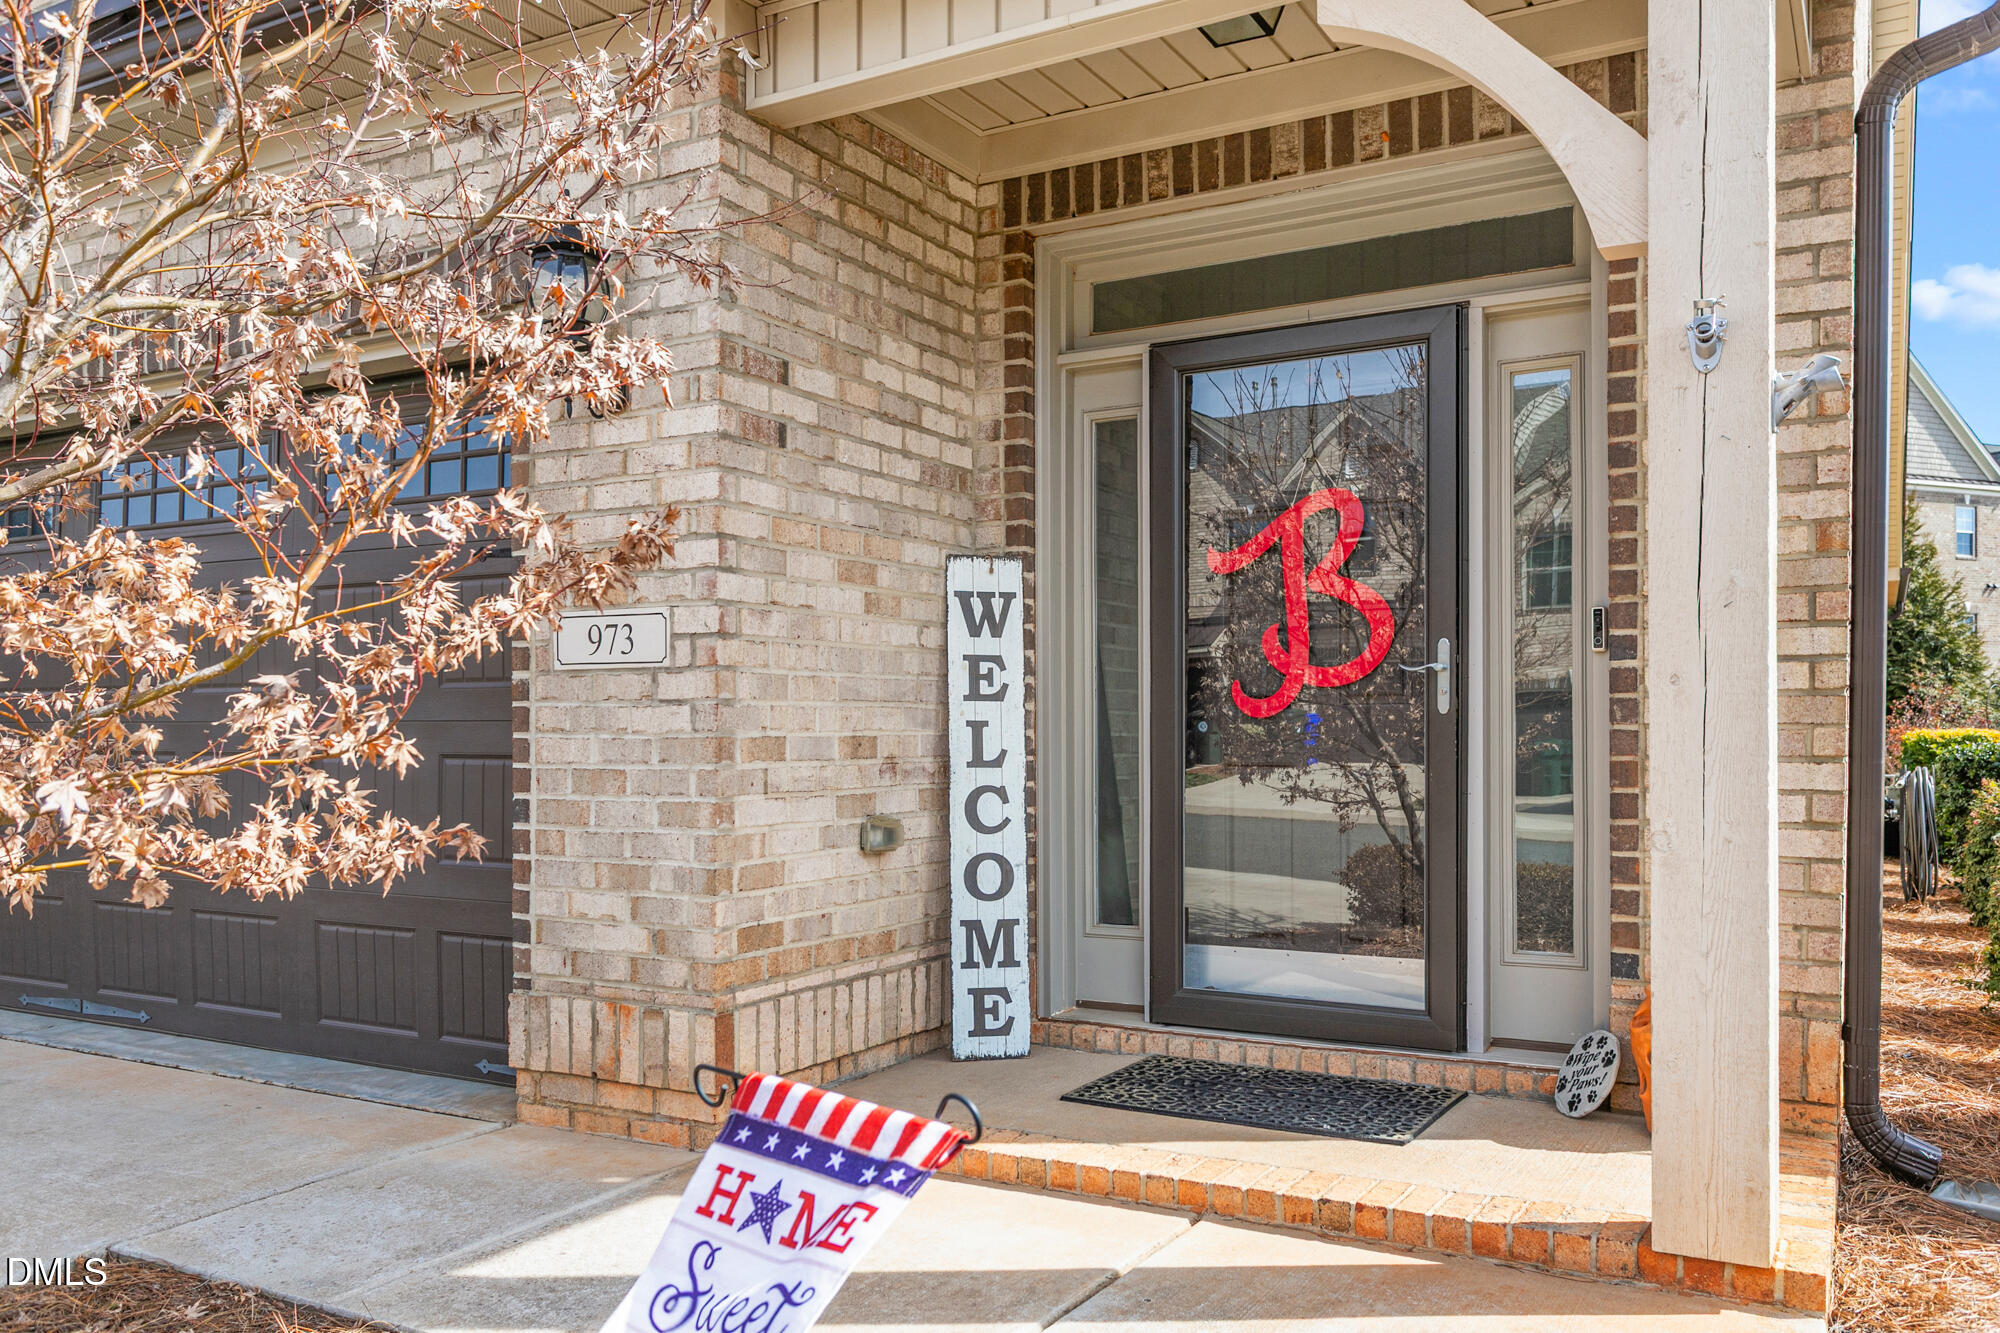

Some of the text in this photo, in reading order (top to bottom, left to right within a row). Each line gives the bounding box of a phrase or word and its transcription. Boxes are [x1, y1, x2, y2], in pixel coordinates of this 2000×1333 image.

[1208, 487, 1395, 718] B
[587, 623, 634, 656] 973
[953, 591, 1021, 1037] WELCOME
[1570, 1064, 1600, 1080] your
[1571, 1051, 1602, 1067] Wipe
[1567, 1072, 1608, 1093] Paws!
[649, 1240, 816, 1333] Sweet
